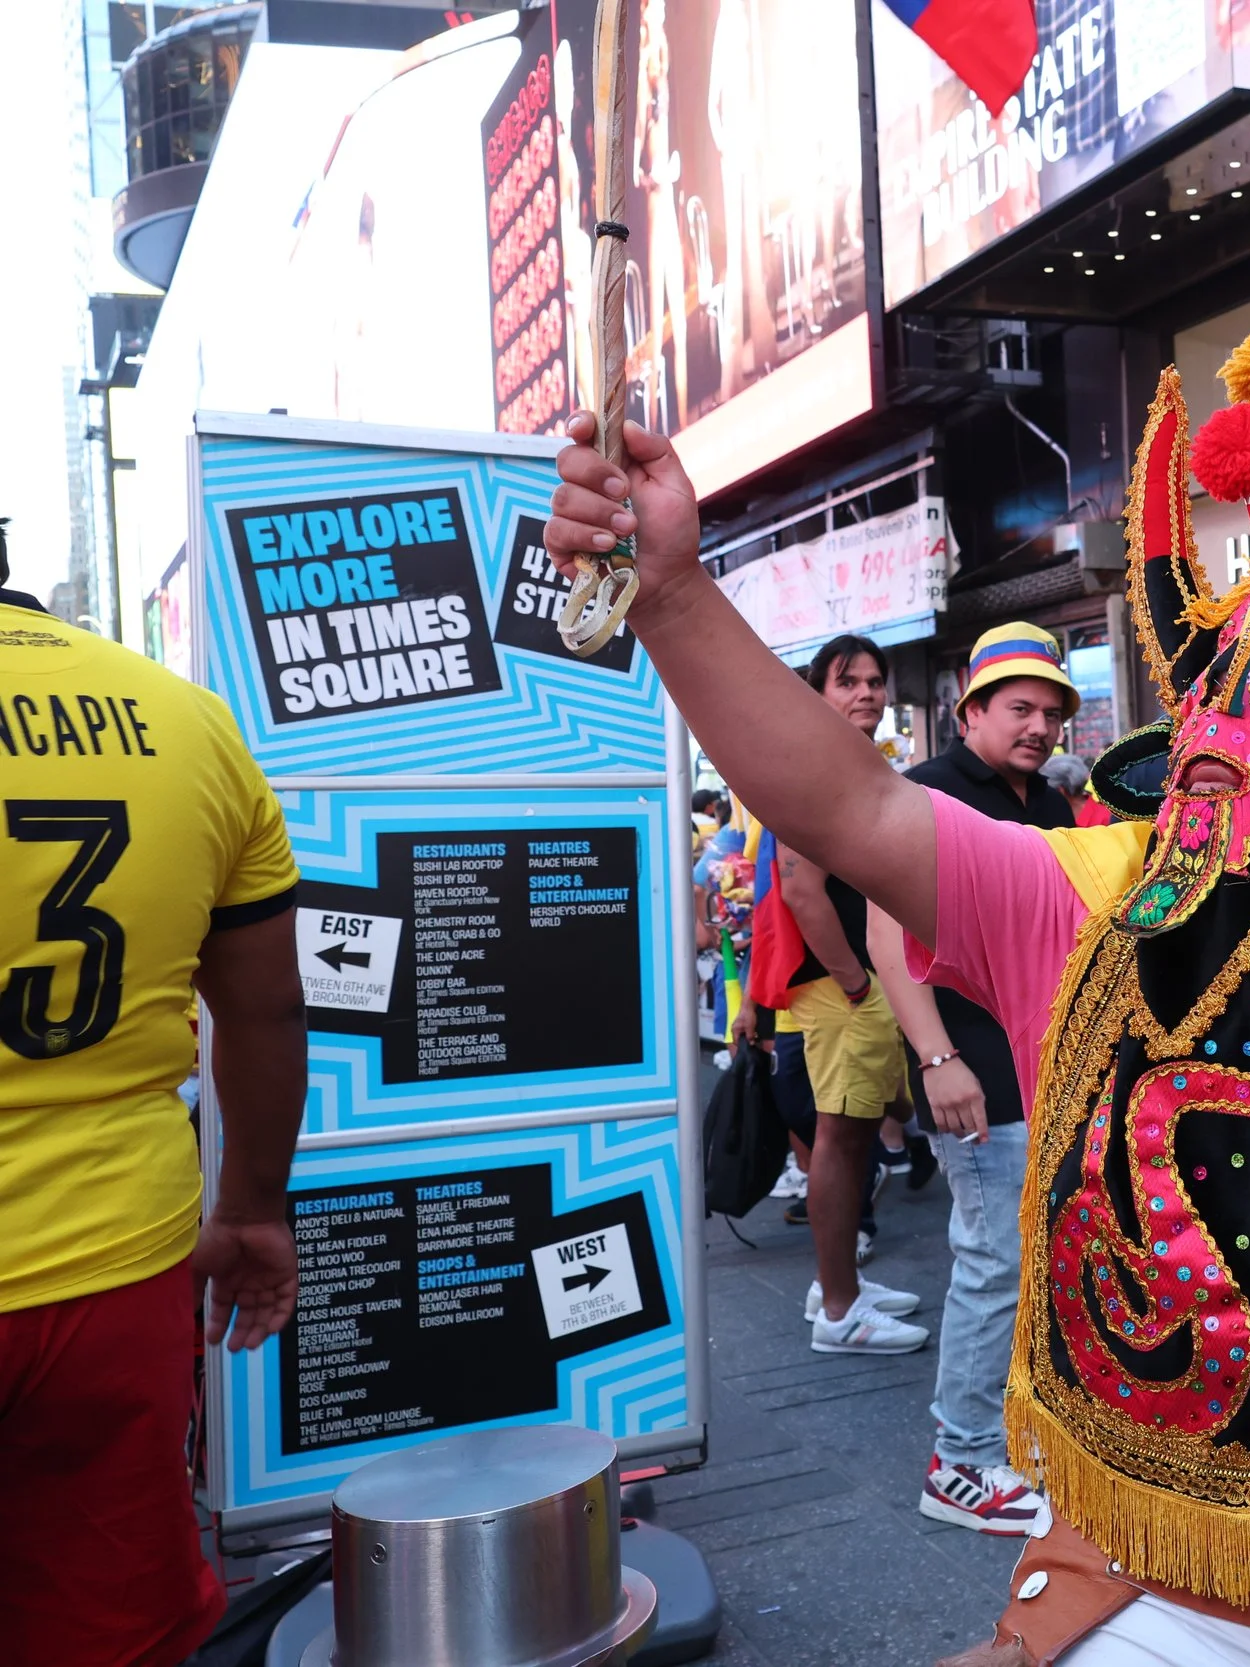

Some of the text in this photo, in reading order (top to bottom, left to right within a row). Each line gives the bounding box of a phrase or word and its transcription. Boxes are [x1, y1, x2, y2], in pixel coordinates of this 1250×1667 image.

[922, 100, 1067, 247] BUILDING
[242, 497, 457, 564] EXPLORE
[255, 553, 399, 614] MORE
[267, 594, 472, 665] IN TIMES
[280, 644, 474, 713] SQUARE
[413, 843, 506, 858] RESTAURANTS
[528, 841, 590, 855] THEATRES
[413, 859, 504, 872] SUSHI LAB ROOFTOP
[528, 856, 599, 868] PALACE THEATRE
[413, 873, 477, 886] SUSHI BY BOU
[529, 874, 584, 888] SHOPS &
[414, 886, 489, 899] HAVEN ROOFTOP
[529, 888, 629, 904] ENTERTAINMENT
[530, 903, 626, 917] HERSHEY'S CHOCOLATE
[0, 799, 130, 1060] 3
[320, 914, 373, 938] EAST
[415, 915, 496, 928] CHEMISTRY ROOM
[530, 917, 561, 928] WORLD
[415, 928, 502, 942] CAPITAL GRAB & GO
[416, 949, 486, 962] THE LONG ACRE
[416, 965, 454, 976] DUNKIN'
[343, 981, 387, 996] 6TH AVE
[416, 977, 466, 990] LOBBY BAR
[476, 985, 505, 994] EDITION
[312, 991, 372, 1006] BROADWAY
[417, 1005, 487, 1019] PARADISE CLUB
[477, 1014, 506, 1023] EDITION
[418, 1033, 500, 1048] THE TERRACE AND
[418, 1044, 506, 1059] OUTDOOR GARDENS
[478, 1054, 507, 1063] EDITION
[415, 1181, 483, 1201] THEATRES
[295, 1191, 394, 1216] RESTAURANTS
[416, 1195, 511, 1215] SAMUEL FRIEDMAN
[295, 1208, 405, 1230] ANDY'S DELI & NATURAL
[416, 1210, 457, 1225] THEATRE
[295, 1227, 329, 1241] FOODS
[417, 1217, 516, 1239] LENA HORNE THEATRE
[296, 1234, 387, 1255] THE MEAN FIDDLER
[417, 1231, 515, 1253] BARRYMORE THEATRE
[556, 1234, 606, 1265] WEST
[297, 1251, 365, 1268] THE WOO WOO
[418, 1254, 476, 1274] SHOPS &
[298, 1260, 400, 1283] TRATTORIA TRECOLORI
[418, 1263, 526, 1290] ENTERTAINMENT
[298, 1277, 376, 1297] BROOKLYN CHOP
[419, 1283, 503, 1304] MOMO LASER HAIR
[297, 1294, 331, 1308] HOUSE
[419, 1299, 462, 1314] REMOVAL
[569, 1292, 614, 1315] BETWEEN
[297, 1298, 402, 1323] GLASS HOUSE TAVERN
[419, 1307, 504, 1328] EDISON BALLROOM
[561, 1300, 628, 1330] 7TH & 8TH AVE
[297, 1318, 356, 1336] FRIEDMAN'S
[298, 1328, 361, 1347] RESTAURANT
[298, 1351, 357, 1369] RUM HOUSE
[298, 1360, 391, 1384] GAYLE'S BROADWAY
[299, 1380, 325, 1394] ROSE
[300, 1388, 367, 1408] DOS CAMINOS
[300, 1406, 343, 1423] BLUE FIN
[300, 1407, 421, 1437] THE LIVING ROOM LOUNGE
